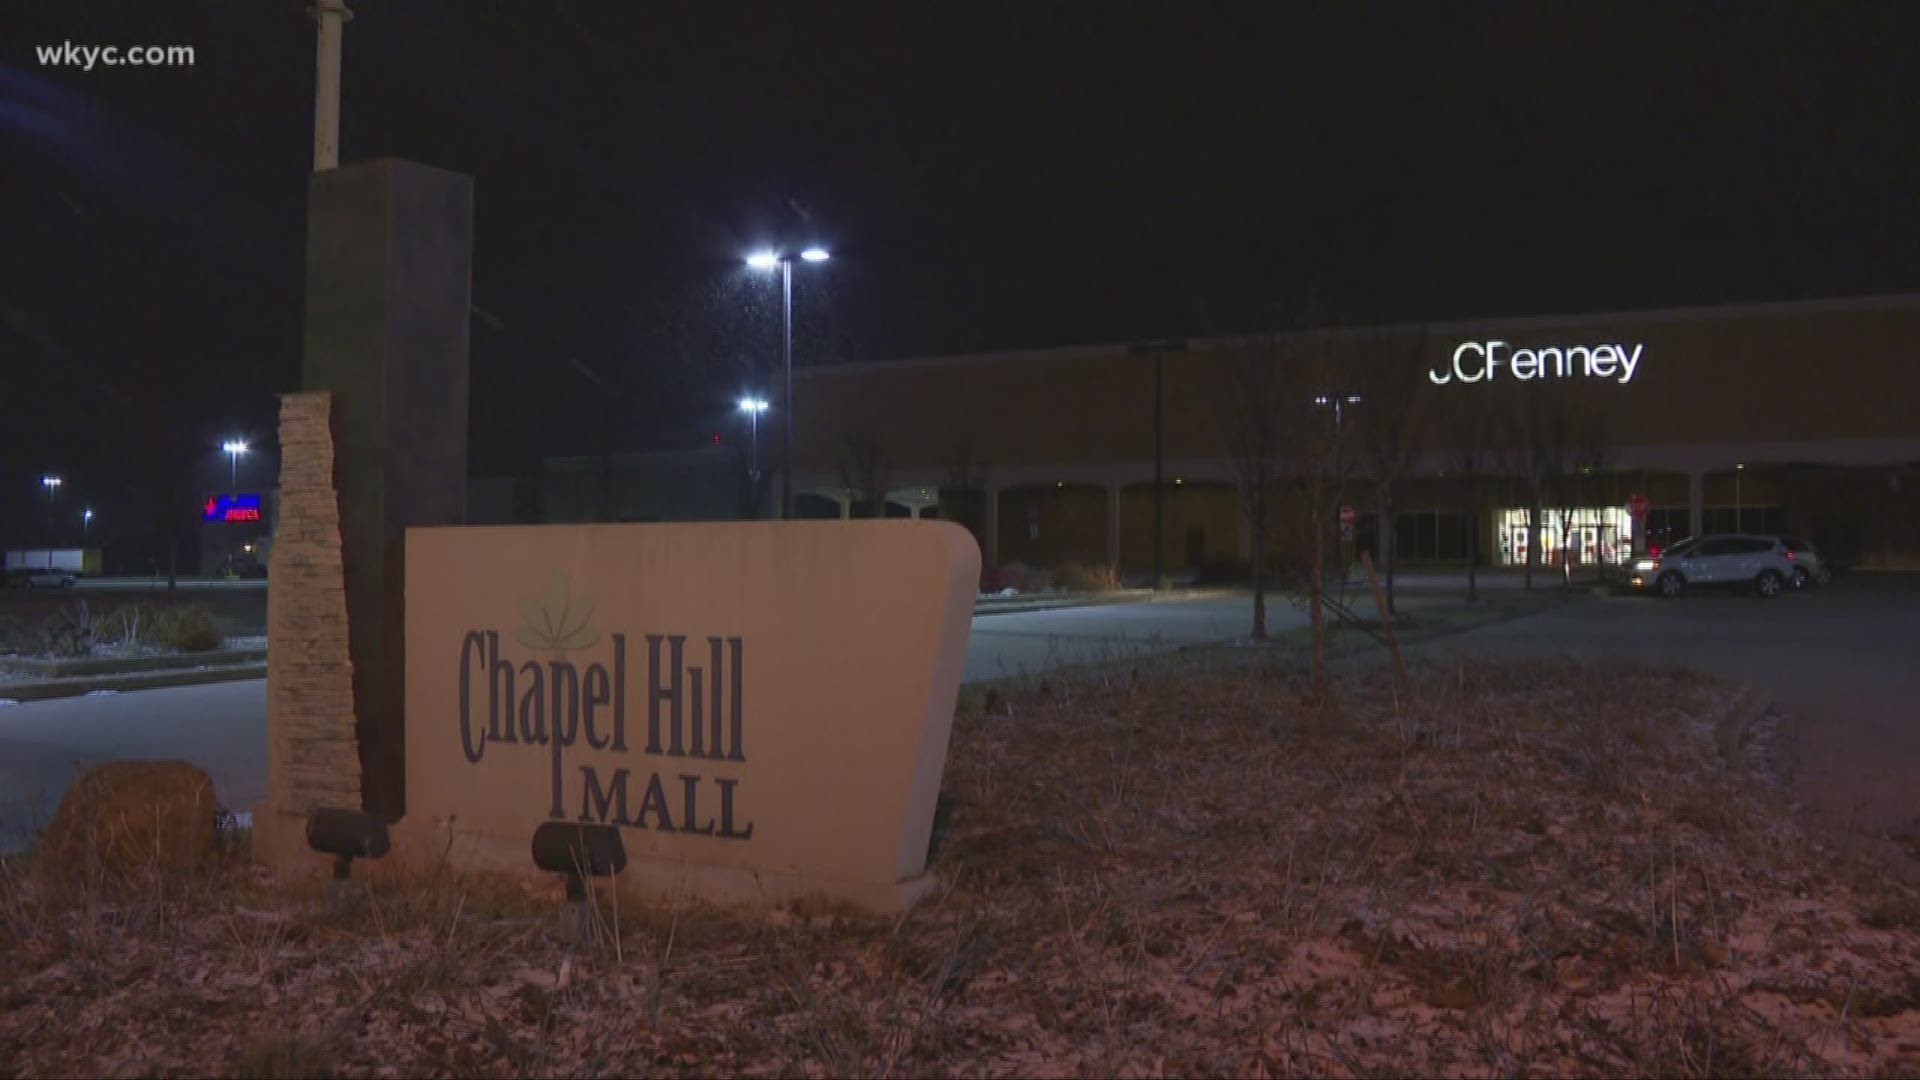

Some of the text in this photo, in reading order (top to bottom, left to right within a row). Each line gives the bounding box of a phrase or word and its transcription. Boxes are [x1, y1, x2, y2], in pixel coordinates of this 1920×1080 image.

[1428, 340, 1644, 385] JCPenney
[459, 629, 746, 817] Chapel Hill
[578, 765, 754, 840] MALL
